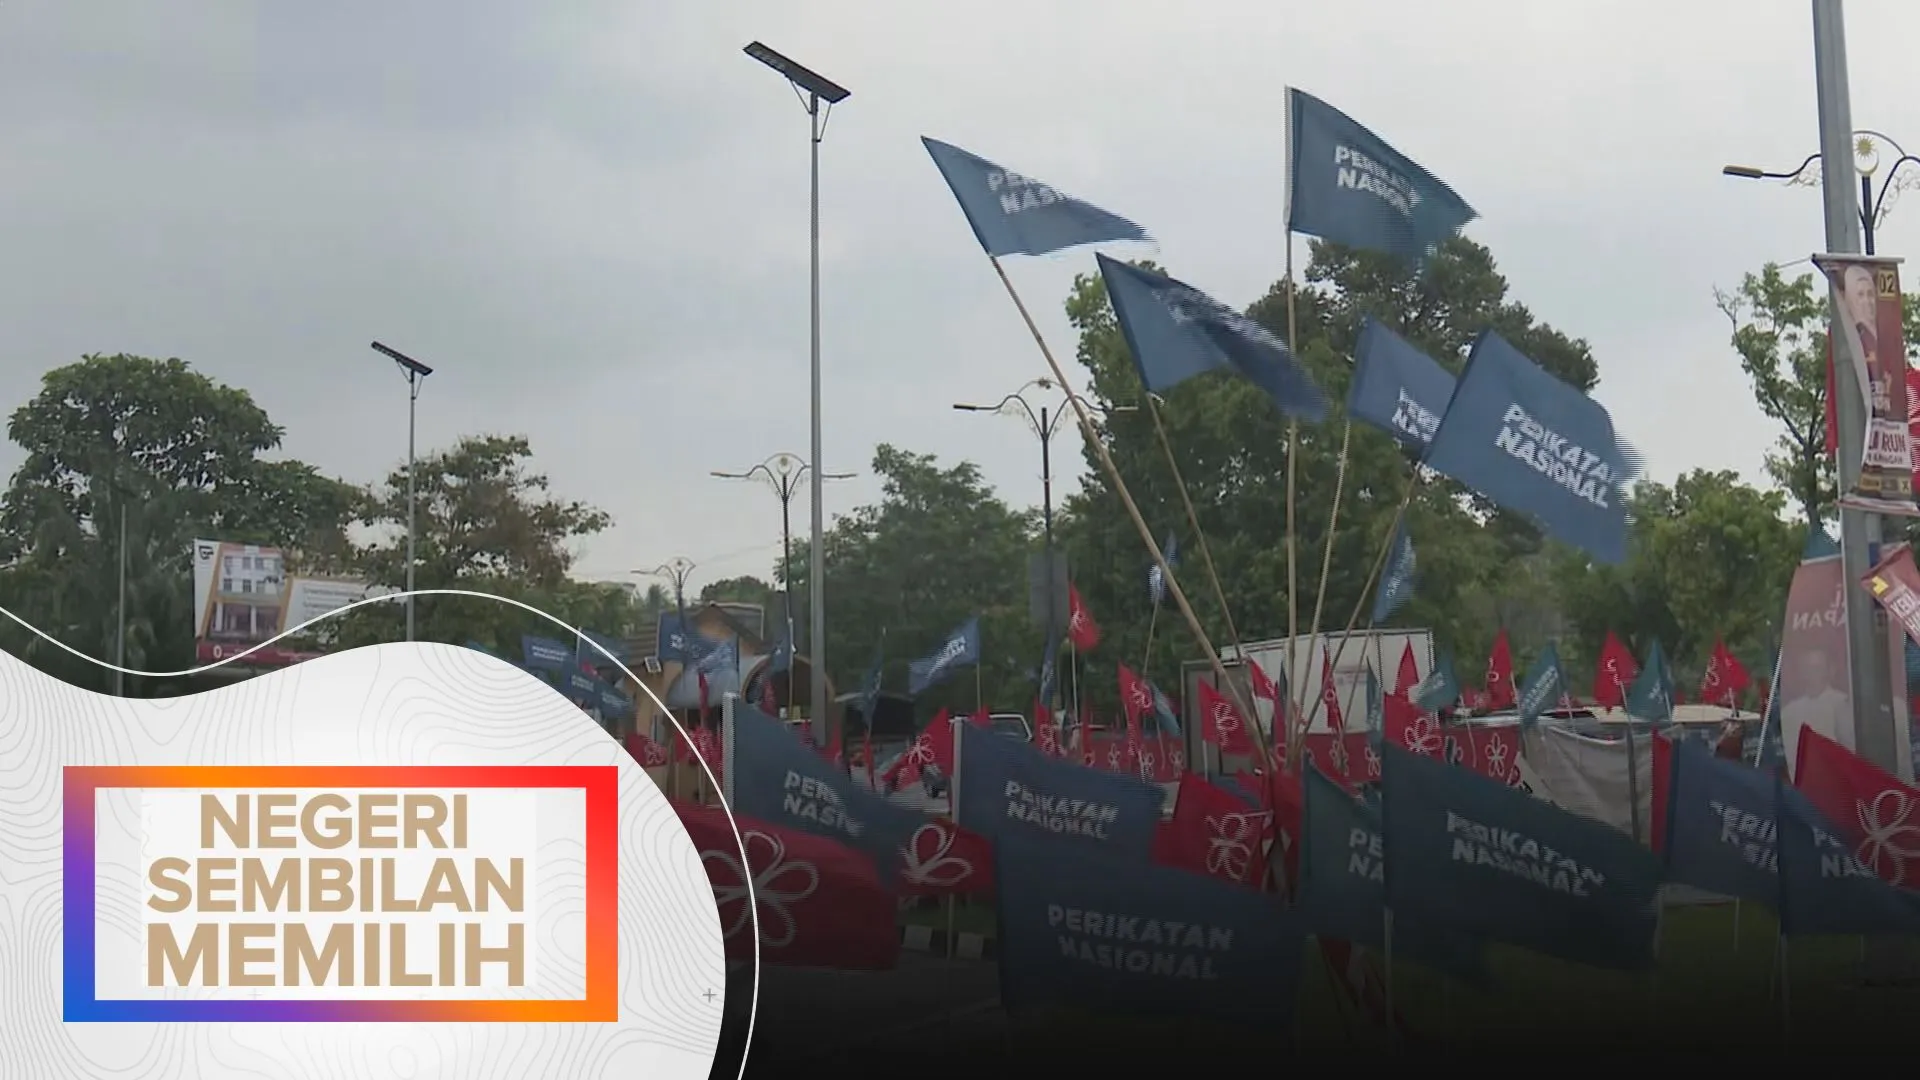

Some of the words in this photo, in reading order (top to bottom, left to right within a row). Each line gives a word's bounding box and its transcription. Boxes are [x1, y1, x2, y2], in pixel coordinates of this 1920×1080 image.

[1880, 273, 1895, 293] 02
[1495, 426, 1609, 508] NASIONAL
[1007, 801, 1109, 840] NAIONAL
[1048, 904, 1234, 951] PERIKATAN
[1058, 935, 1219, 979] NASIONAL
